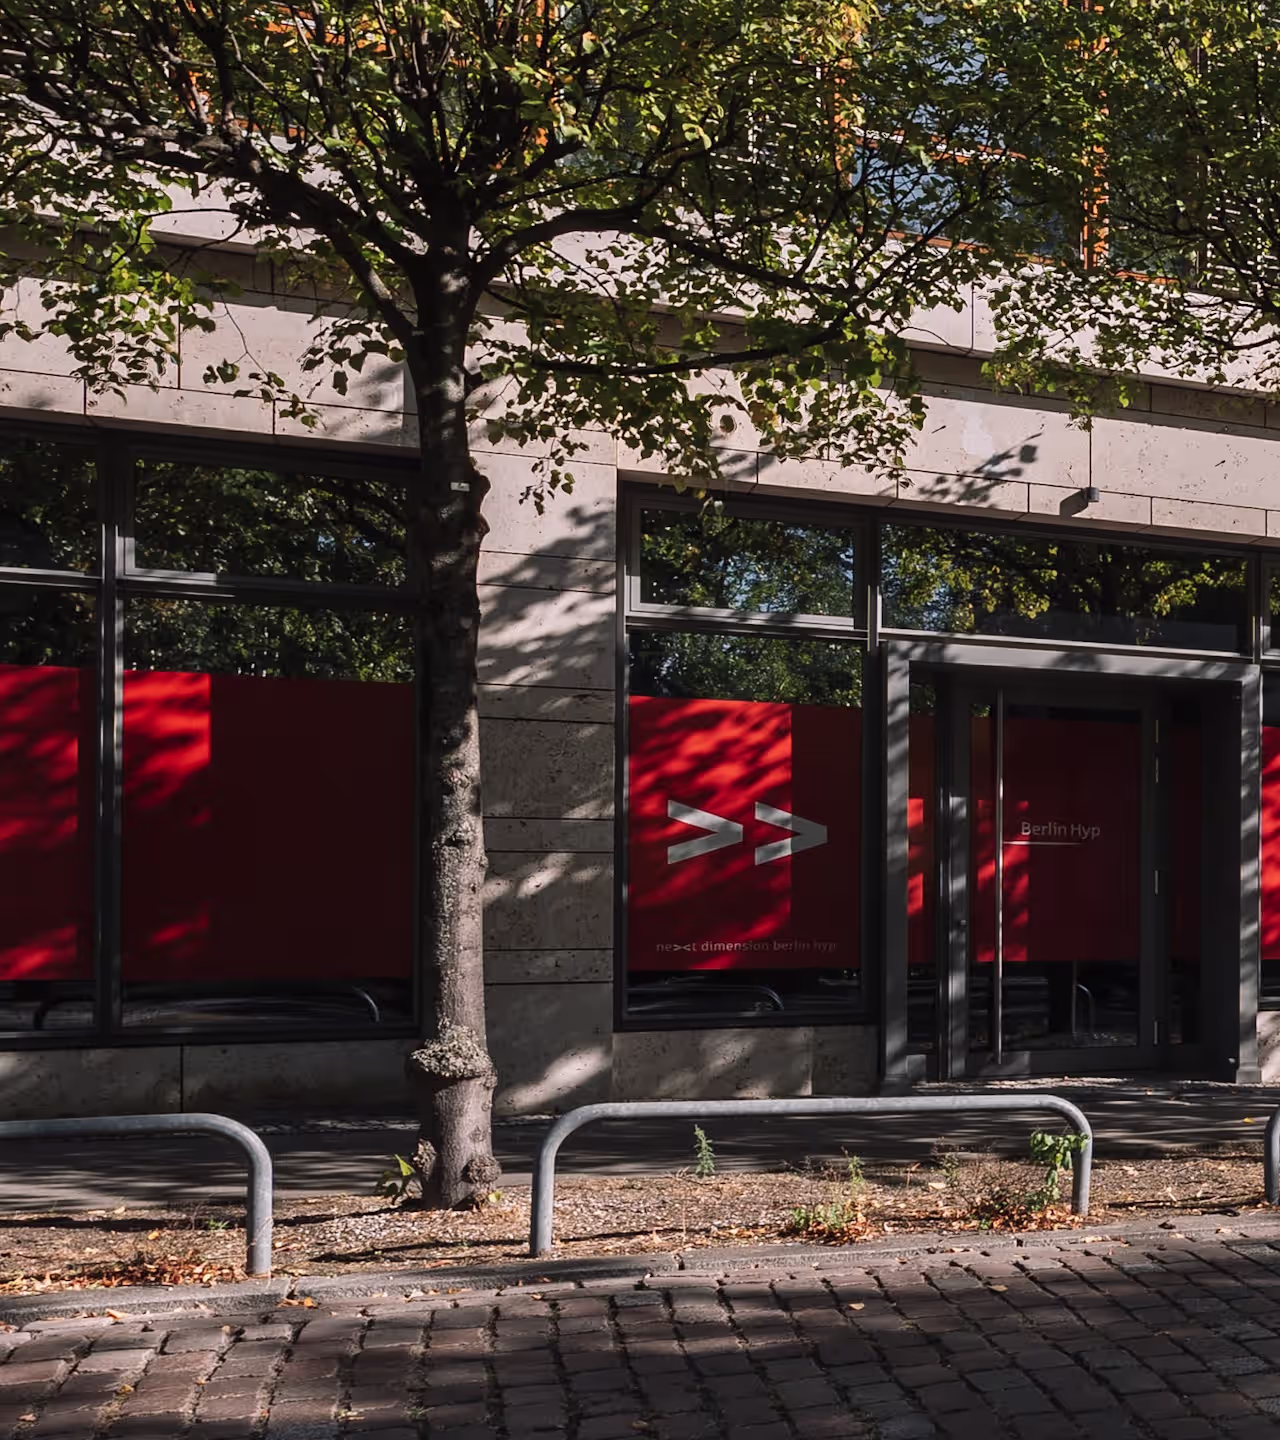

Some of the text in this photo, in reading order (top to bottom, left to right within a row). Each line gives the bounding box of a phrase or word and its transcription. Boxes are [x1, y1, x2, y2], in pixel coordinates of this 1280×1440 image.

[1020, 820, 1101, 840] Berlin Hyp
[701, 940, 769, 952] dimension
